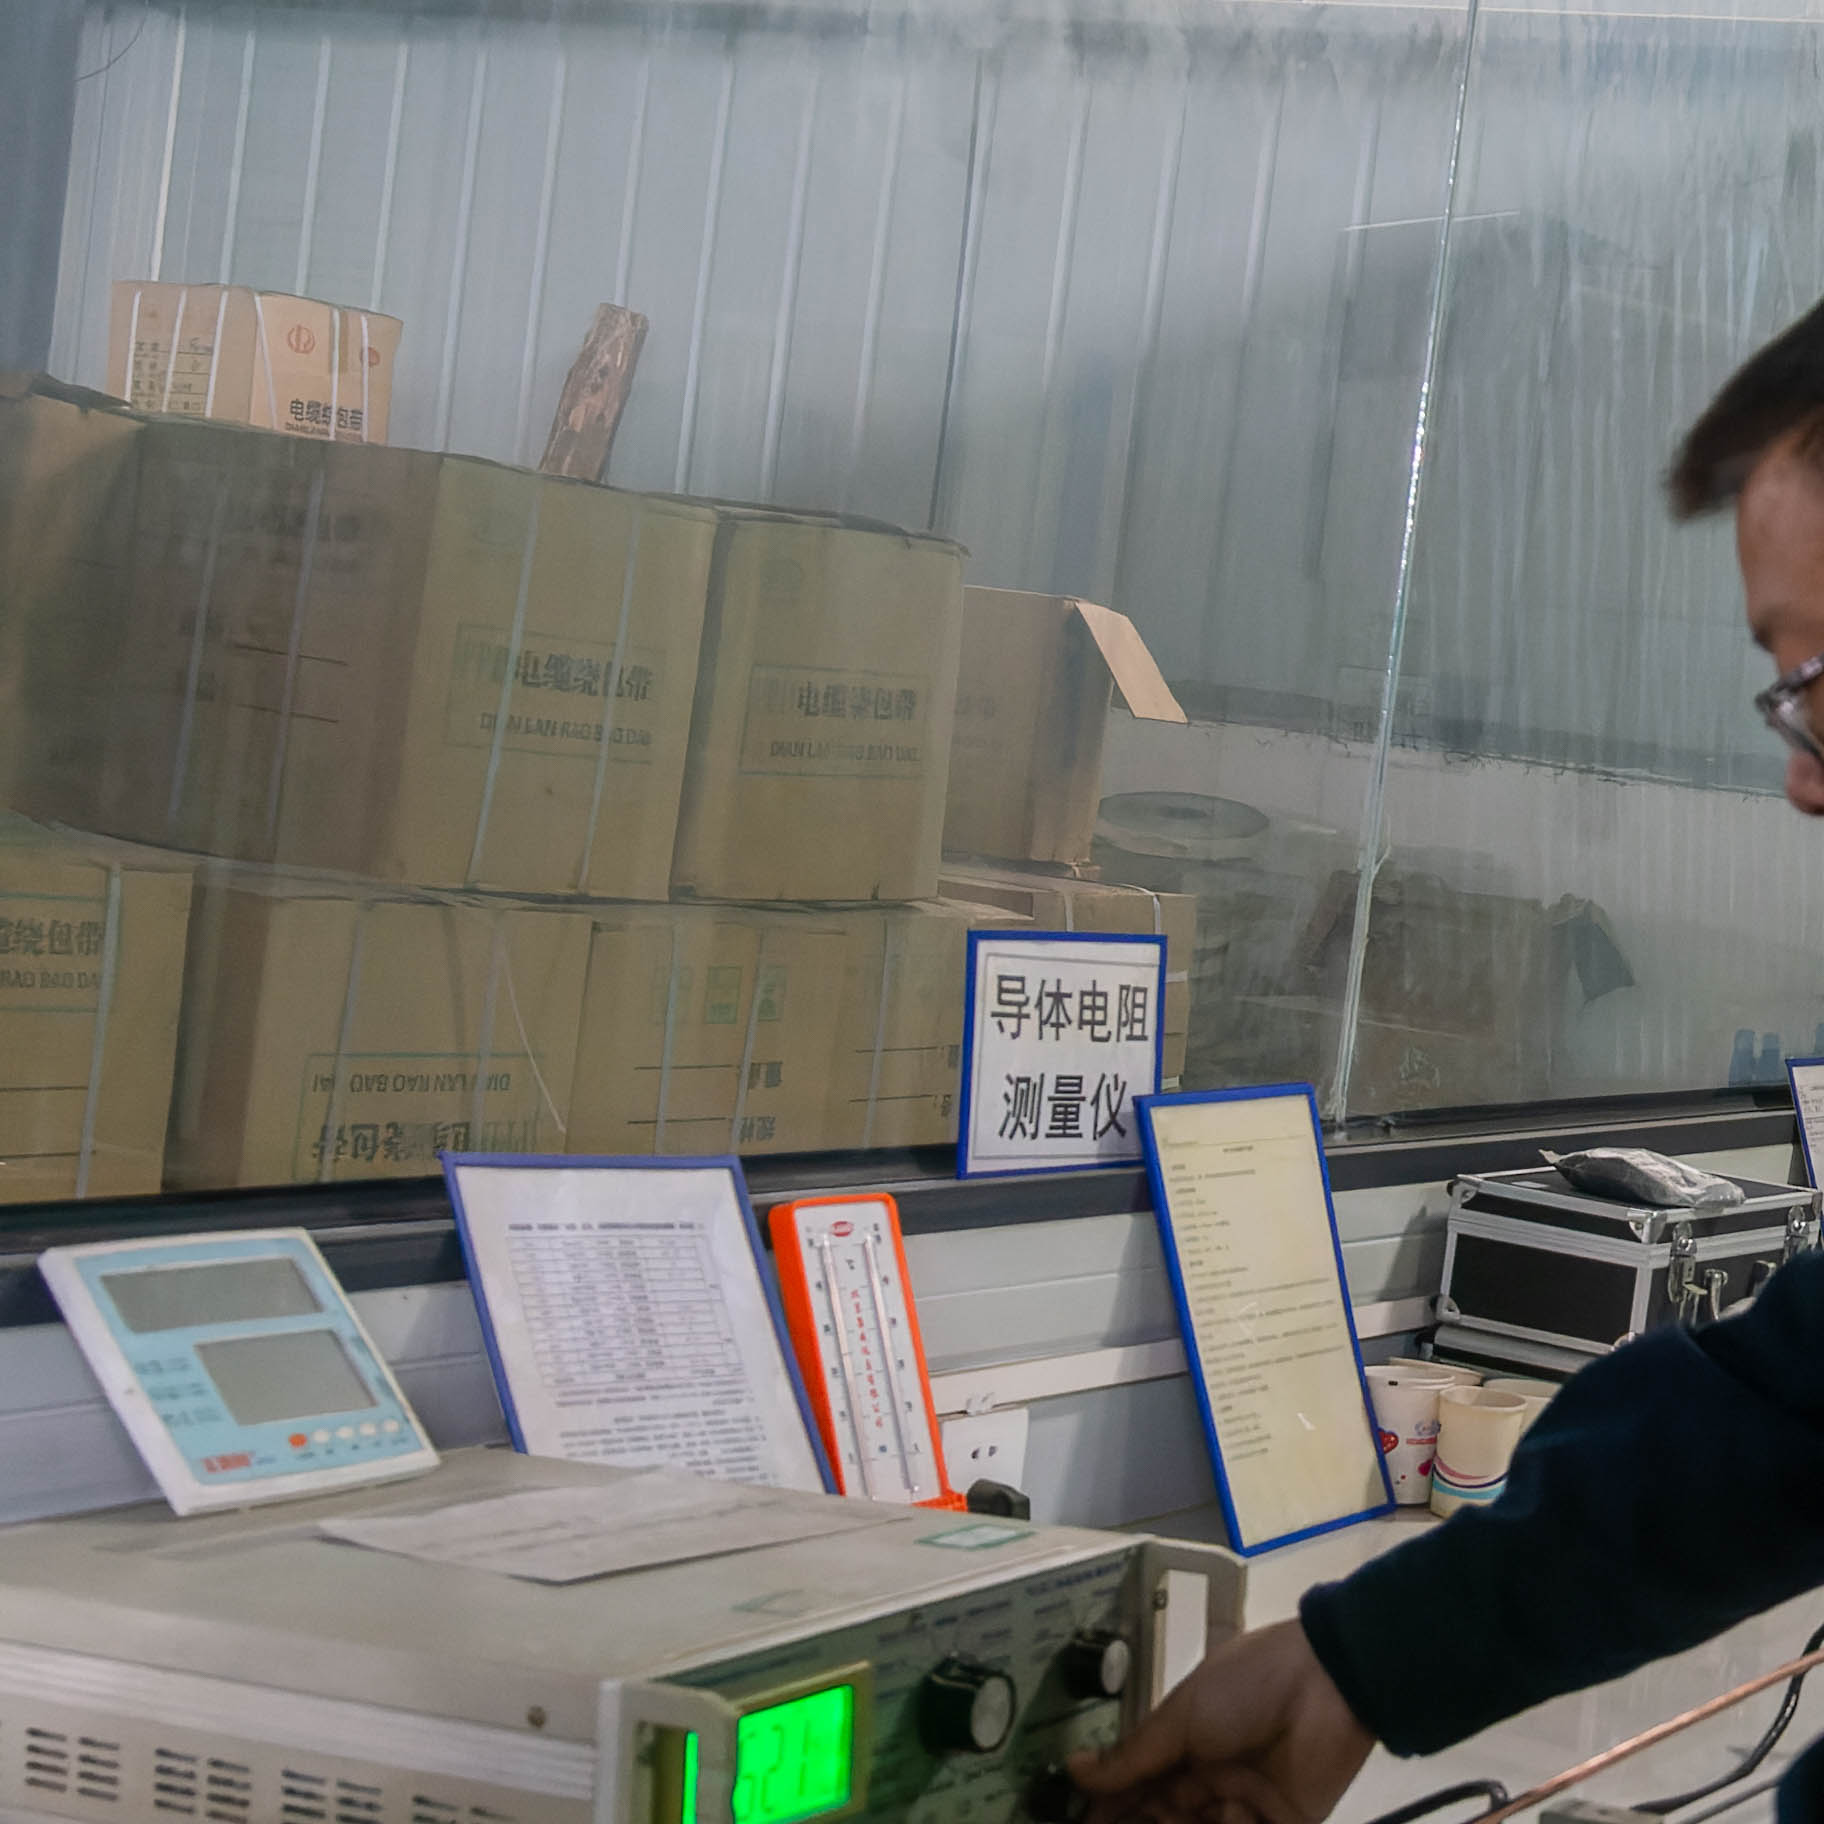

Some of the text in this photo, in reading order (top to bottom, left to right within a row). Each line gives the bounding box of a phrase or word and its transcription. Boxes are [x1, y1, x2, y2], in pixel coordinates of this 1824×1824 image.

[990, 974, 1149, 1043] 导体电阻
[998, 1072, 1128, 1141] 测量仪
